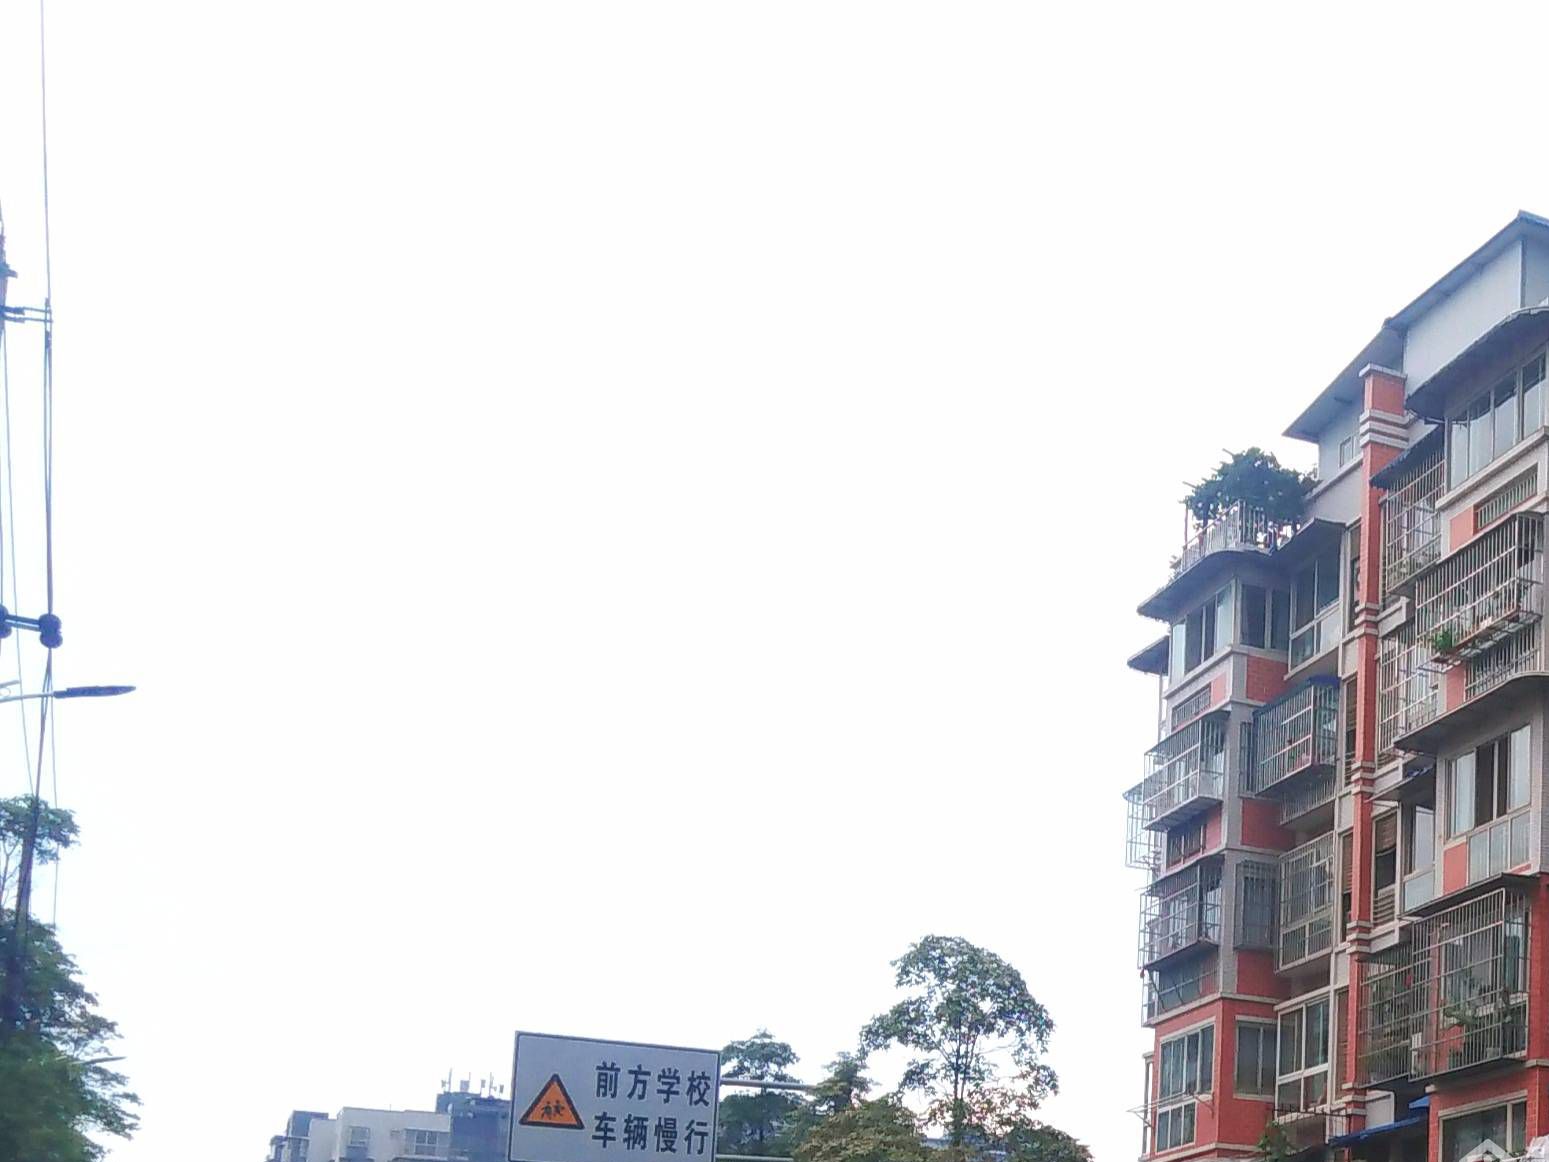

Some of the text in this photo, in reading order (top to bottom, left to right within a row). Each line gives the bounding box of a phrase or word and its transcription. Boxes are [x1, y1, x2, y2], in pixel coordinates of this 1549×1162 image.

[595, 1061, 711, 1107] 前方学校
[591, 1111, 709, 1155] 车辆慢行
